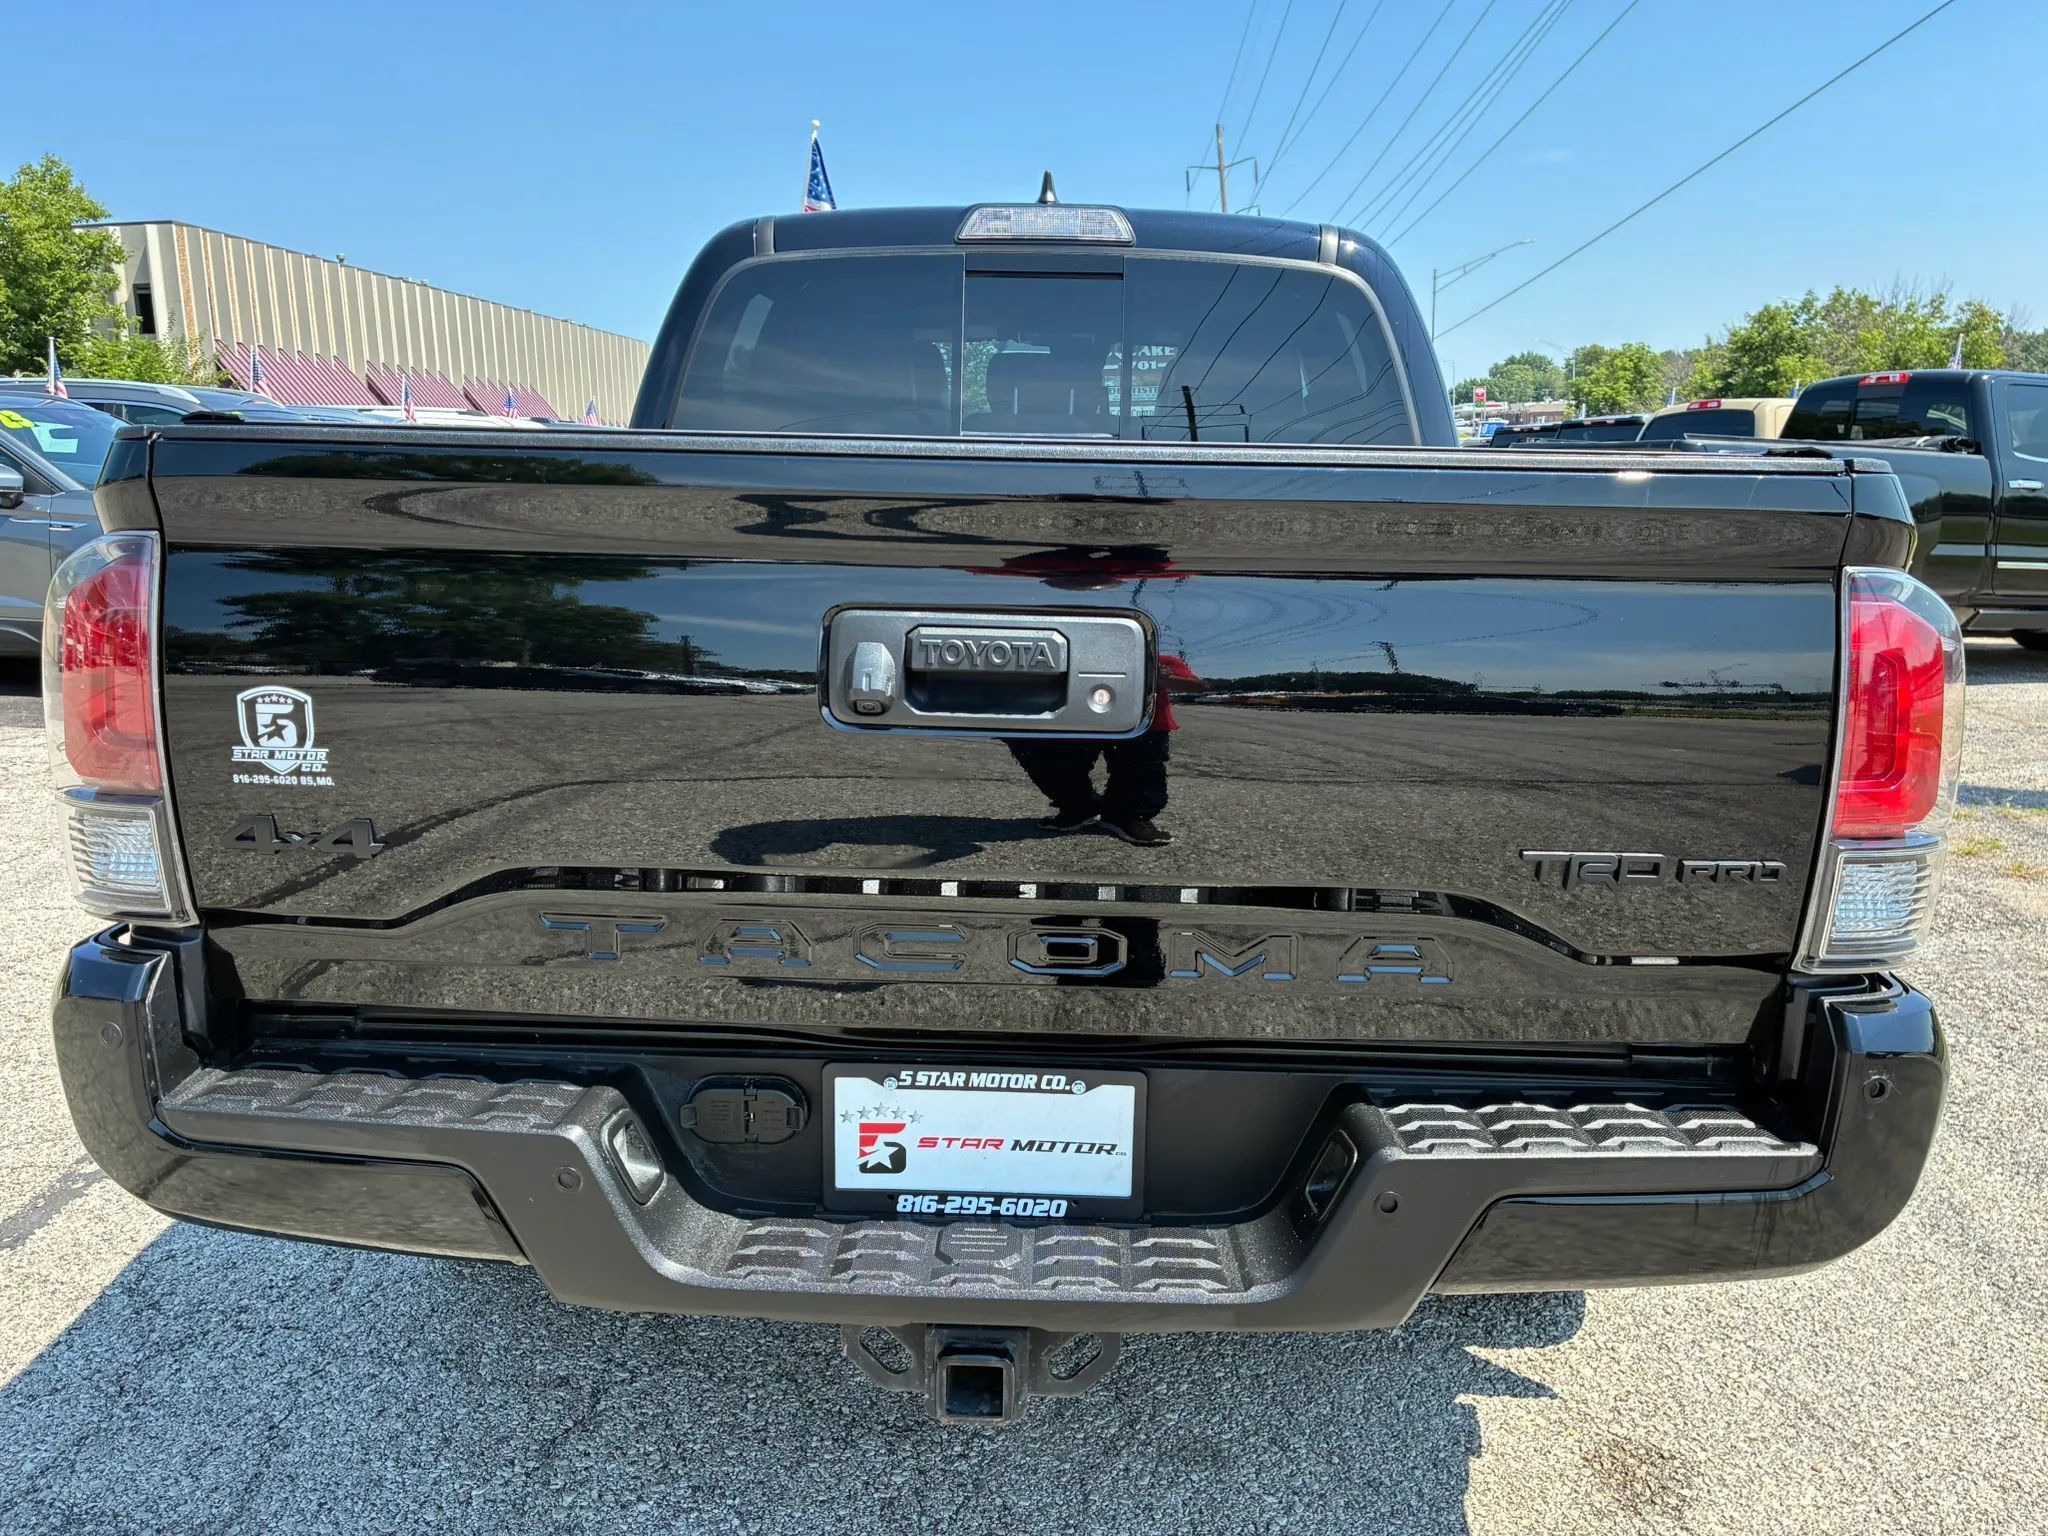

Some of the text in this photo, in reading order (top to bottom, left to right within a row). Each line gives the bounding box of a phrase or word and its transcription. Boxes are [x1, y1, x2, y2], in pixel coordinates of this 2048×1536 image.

[919, 639, 1056, 669] TOYOTA
[233, 749, 327, 761] STAR MOTOR
[301, 763, 326, 772] CO.
[232, 774, 298, 785] 816-295-6020
[1519, 850, 1787, 895] TRD PRO
[538, 911, 1454, 985] TACOMA
[898, 1070, 1071, 1091] 5 STAR MOTOR CO.
[917, 1136, 1005, 1151] STAR
[1010, 1139, 1119, 1156] MOTOR
[896, 1194, 1068, 1218] 816-295-6020
